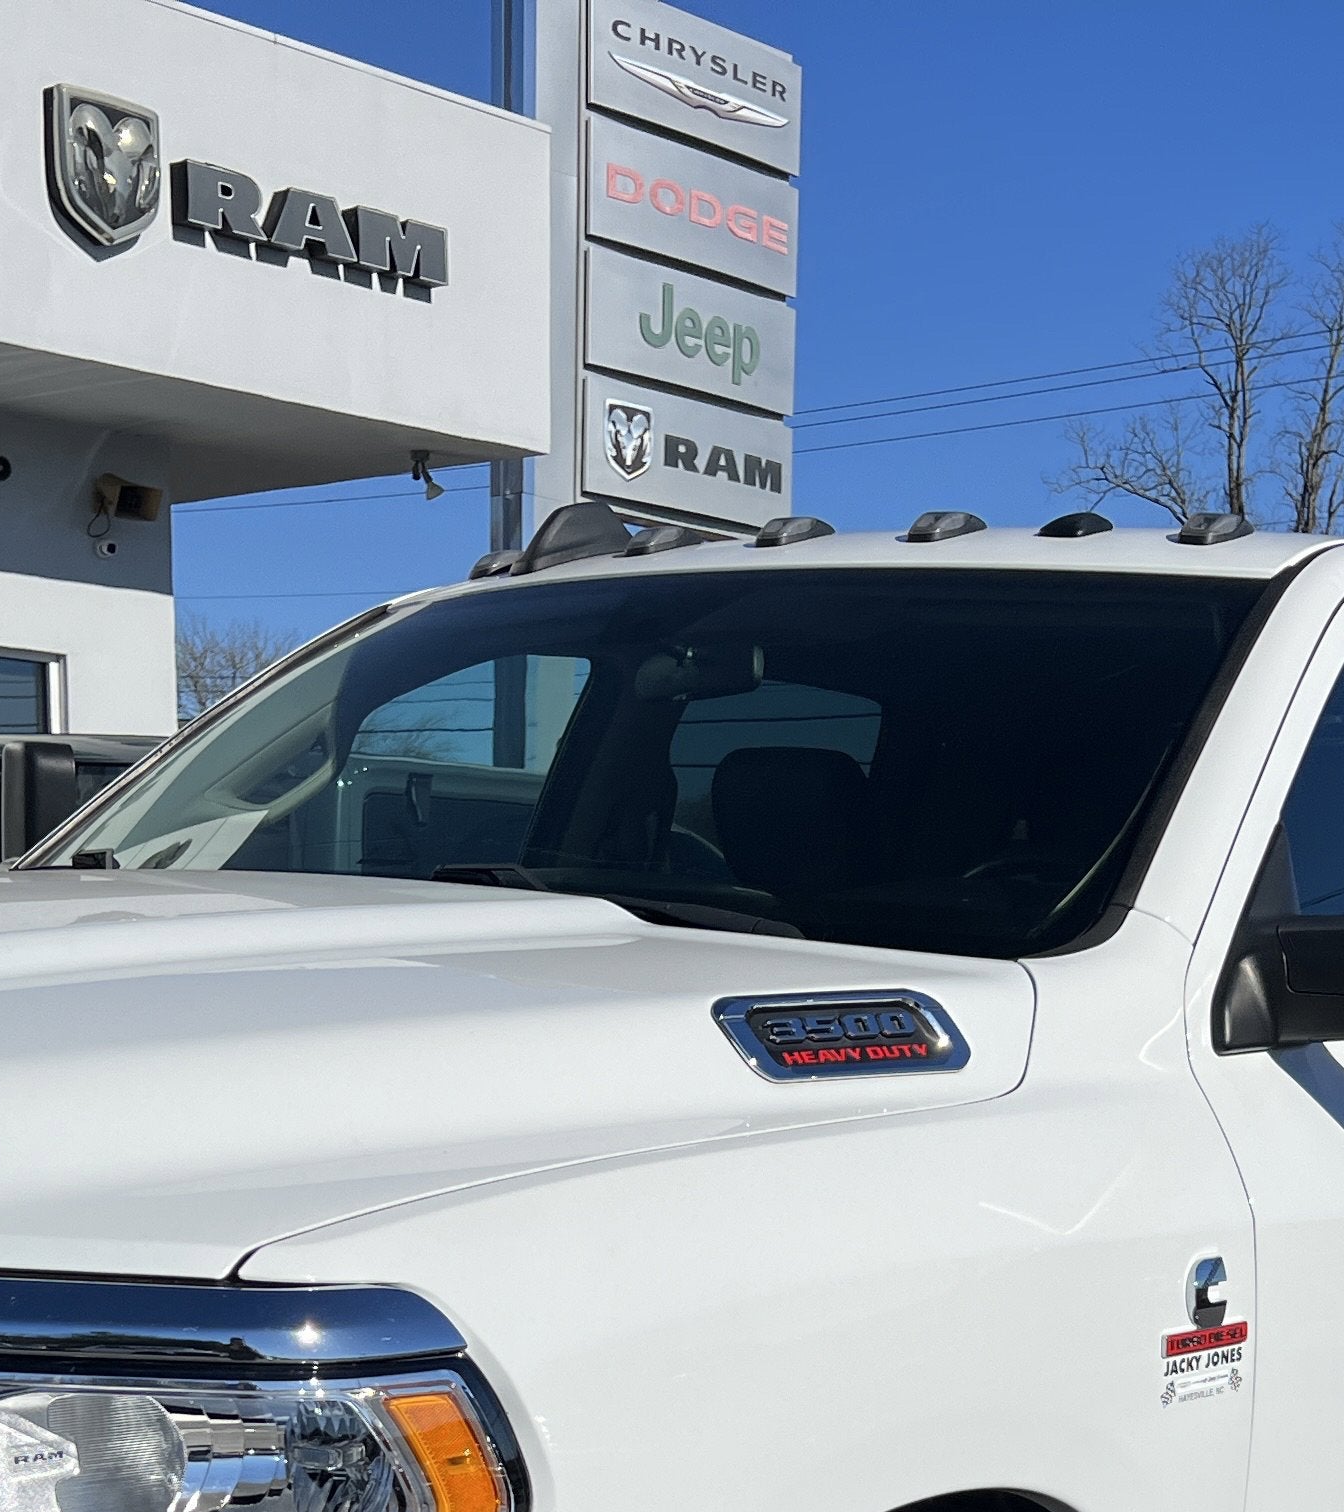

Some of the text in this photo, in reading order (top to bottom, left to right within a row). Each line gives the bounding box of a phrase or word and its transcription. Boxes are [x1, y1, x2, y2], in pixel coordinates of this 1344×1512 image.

[611, 19, 788, 102] CHRYSLER
[170, 157, 449, 288] RAM
[606, 162, 789, 255] DODGE
[638, 282, 760, 385] Jeep
[663, 433, 783, 494] RAM
[762, 1011, 919, 1044] 3500
[782, 1043, 928, 1066] HEAVY DUTY
[1164, 1346, 1242, 1377] JACKY JONES
[14, 1450, 64, 1465] RAM
